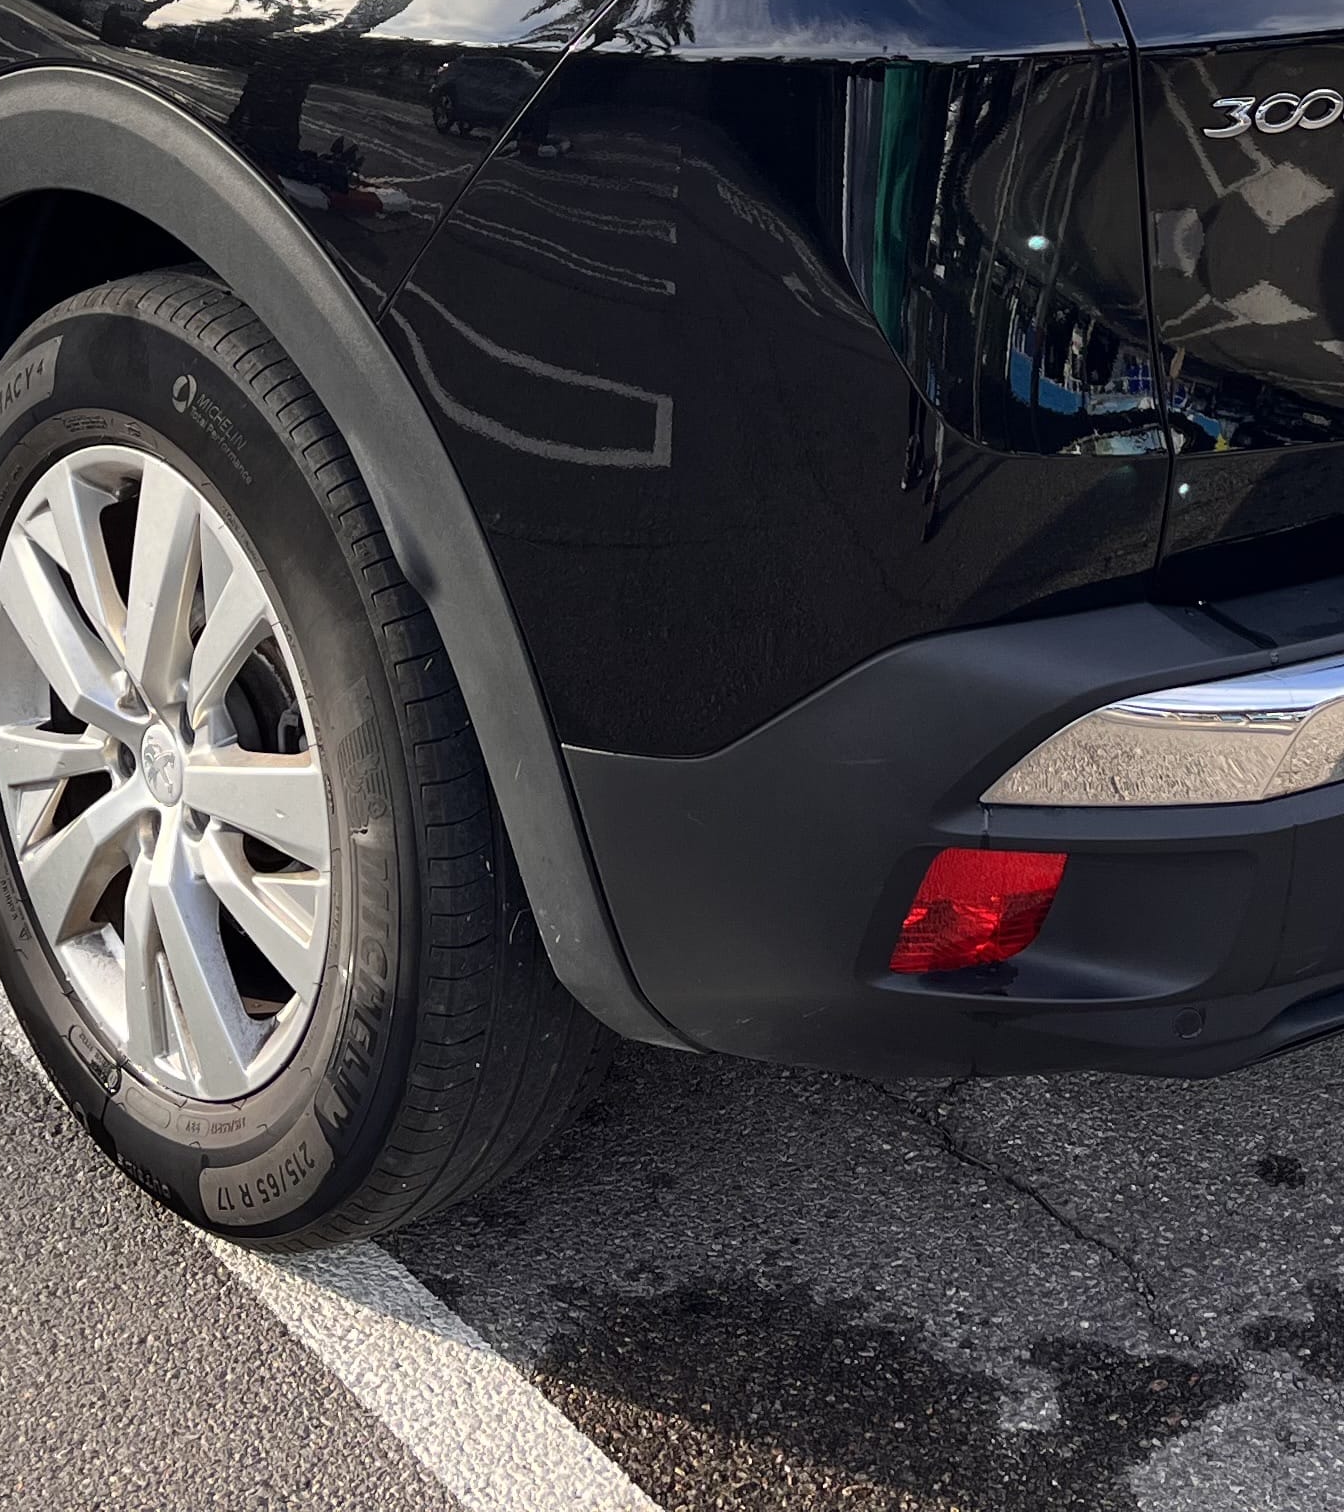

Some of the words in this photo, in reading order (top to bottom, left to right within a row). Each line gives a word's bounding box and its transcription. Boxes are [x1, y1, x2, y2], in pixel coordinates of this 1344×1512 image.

[36, 357, 45, 377] 4
[196, 393, 248, 451] MICHELIN
[322, 856, 391, 1132] MICHELIN
[260, 1140, 316, 1204] 215/65
[216, 1186, 236, 1211] 17
[240, 1184, 254, 1209] R
